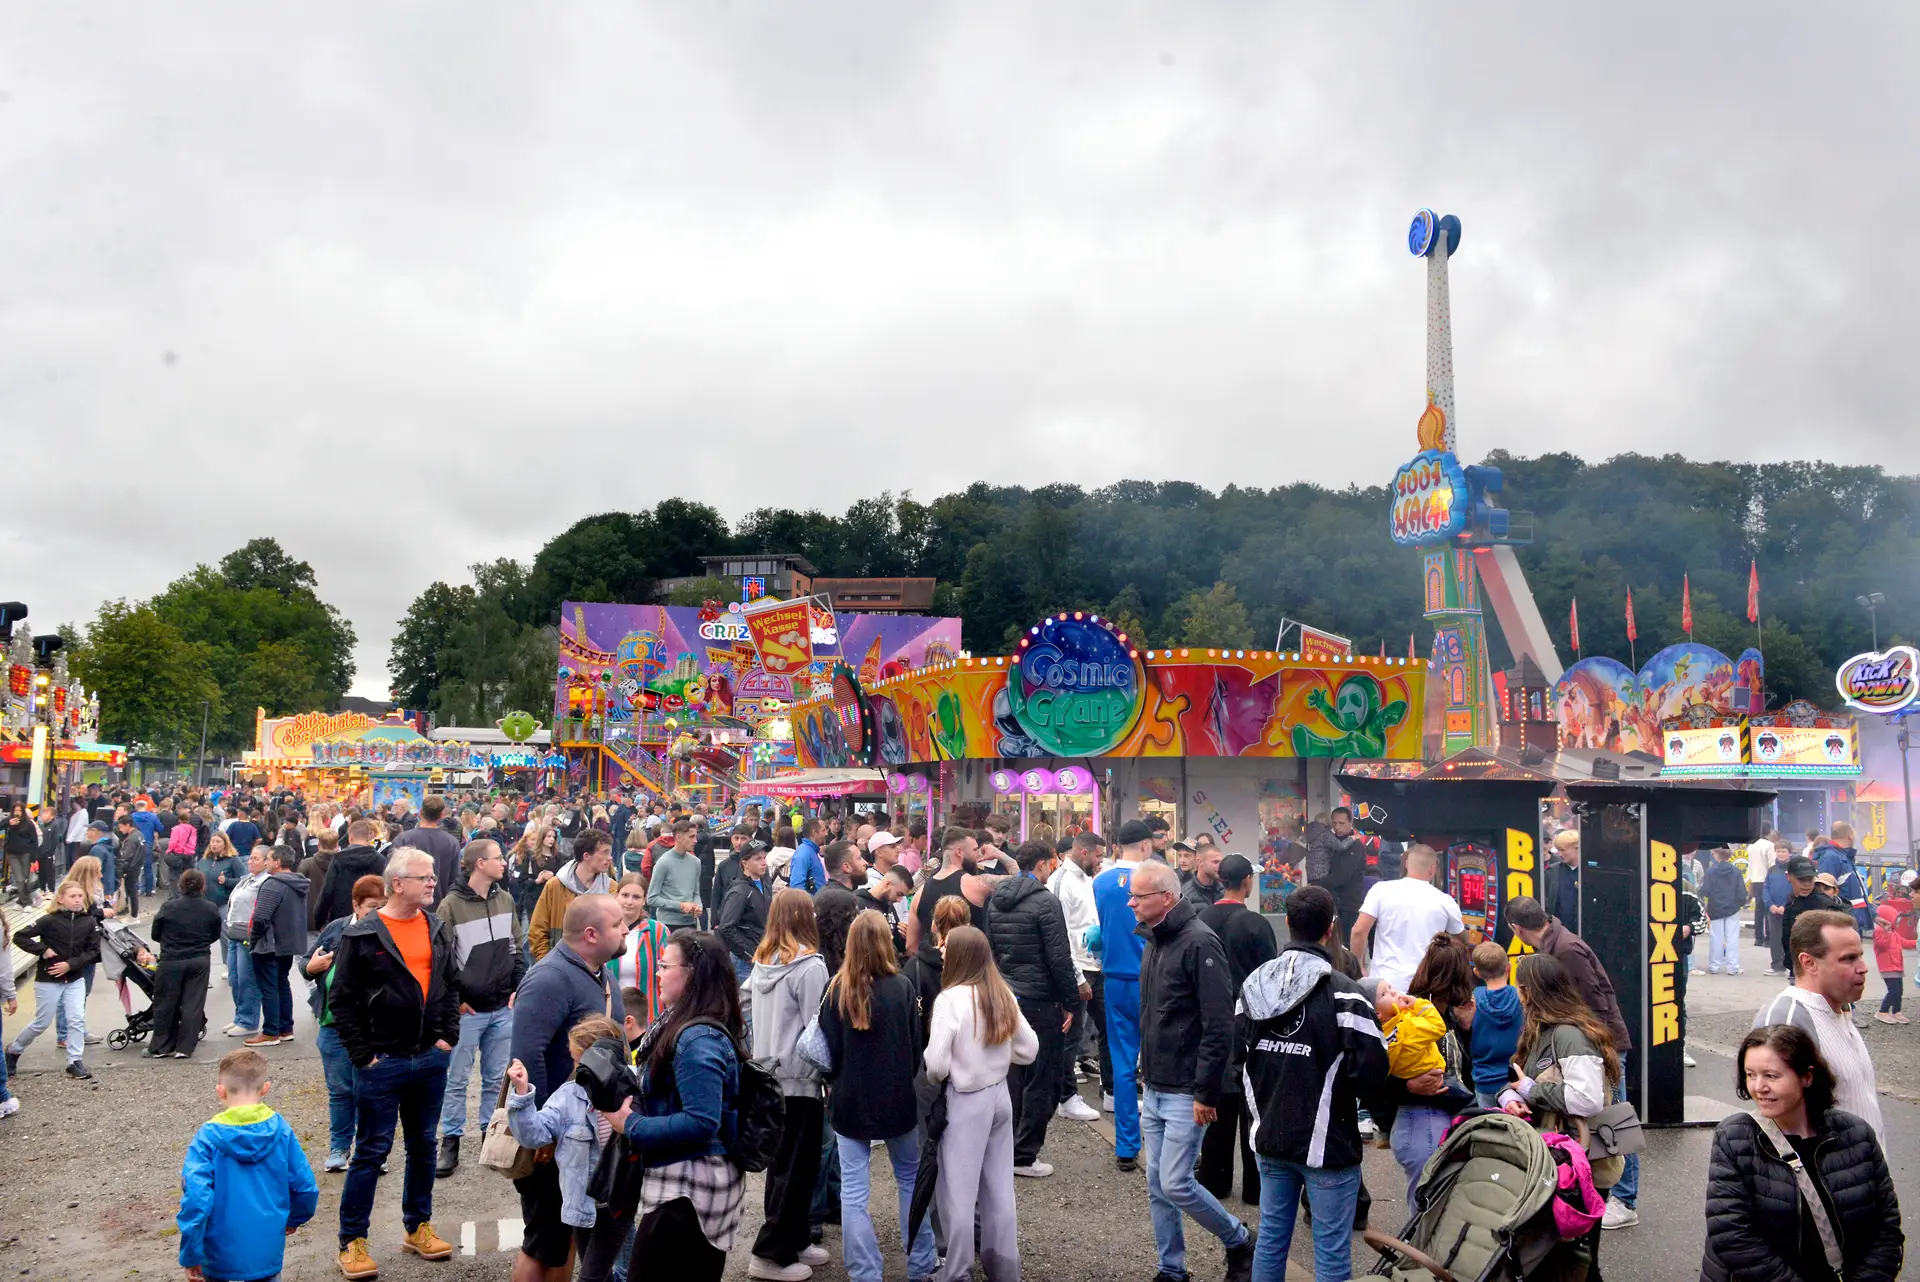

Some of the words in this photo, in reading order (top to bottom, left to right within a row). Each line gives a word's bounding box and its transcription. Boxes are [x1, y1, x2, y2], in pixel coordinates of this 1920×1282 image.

[701, 624, 750, 640] CRAZ
[763, 622, 799, 636] Kasse
[1022, 643, 1130, 687] Cosmic
[1852, 660, 1898, 683] KICK
[1852, 677, 1909, 699] DOWN
[282, 711, 369, 748] Spezialitäten
[1193, 790, 1234, 844] SPIEL
[1876, 807, 1885, 845] EXIT
[1649, 839, 1679, 1047] BOXER
